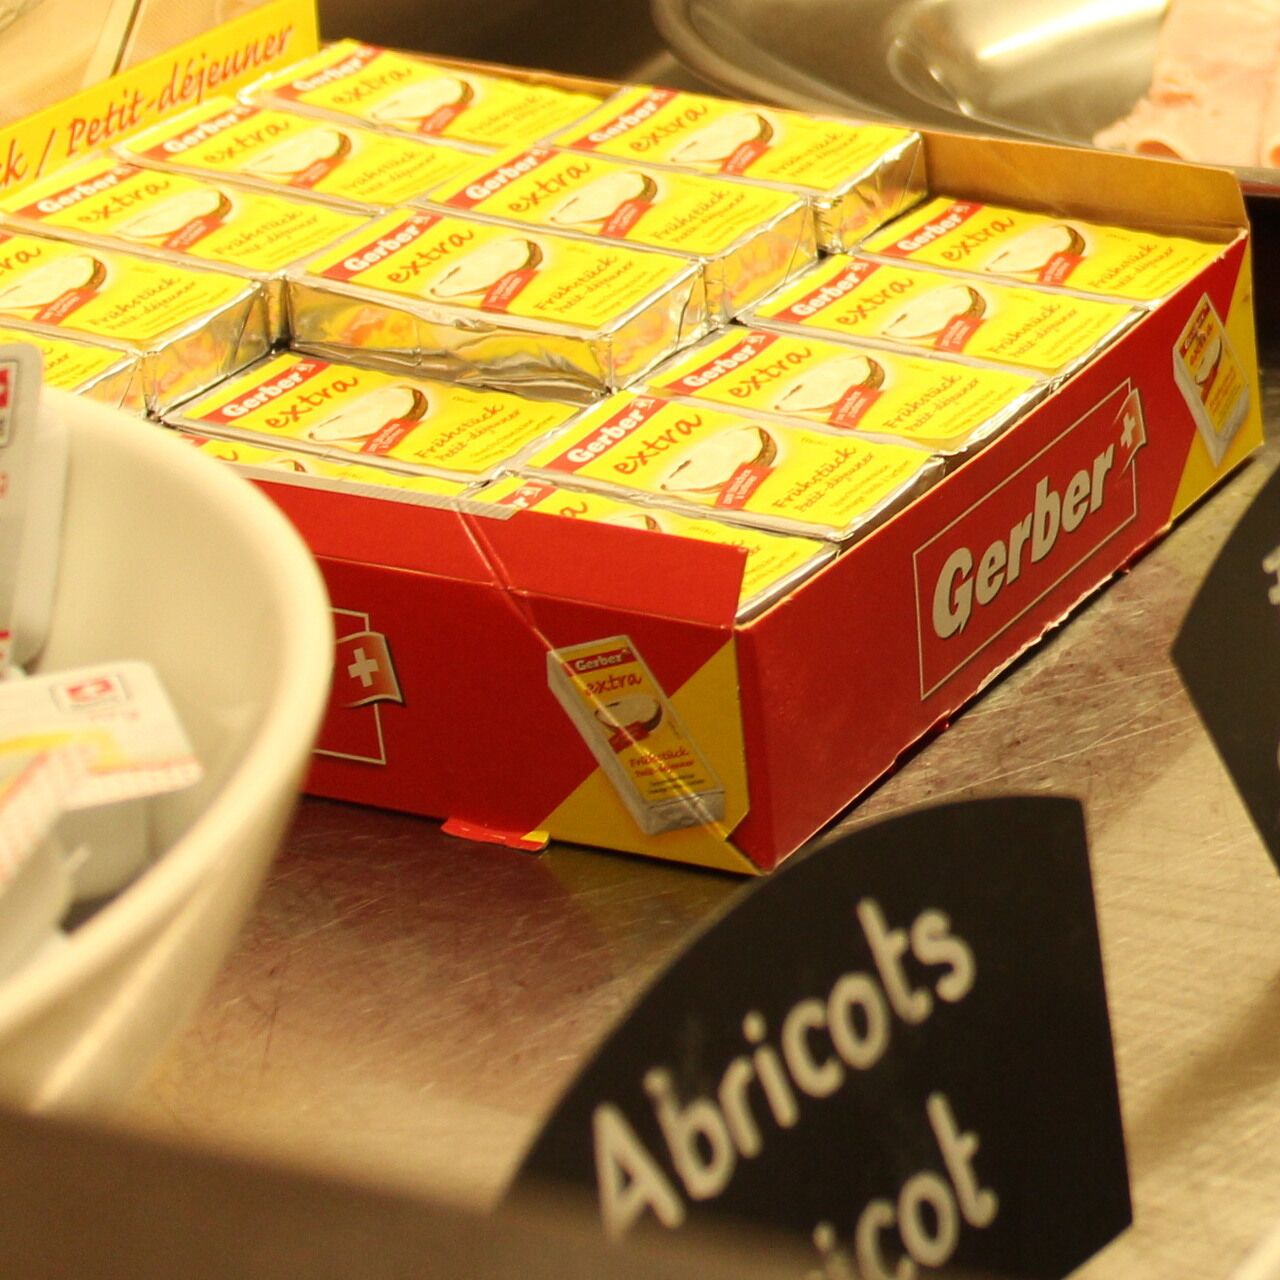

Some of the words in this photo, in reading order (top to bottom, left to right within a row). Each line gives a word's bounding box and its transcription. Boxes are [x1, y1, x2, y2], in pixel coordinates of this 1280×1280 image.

[65, 24, 294, 157] Petit-déjeuner
[588, 98, 658, 143] Gerber
[630, 103, 709, 152] extra
[465, 157, 540, 200] Gerber
[508, 162, 591, 213] extra
[343, 223, 421, 272] Gerber
[897, 211, 965, 252] Gerber
[941, 216, 1015, 263] extra
[387, 229, 474, 284] extra
[791, 271, 860, 317] Gerber
[838, 278, 914, 327] extra
[682, 342, 756, 388] Gerber
[729, 347, 813, 399] extra
[221, 370, 304, 418] Gerber
[265, 375, 359, 429] extra
[567, 408, 646, 464] Gerber
[614, 413, 702, 476] extra
[773, 446, 857, 510] Frühstück
[931, 443, 1115, 639] Gerber
[575, 652, 623, 671] Gerber
[585, 672, 643, 696] extra
[593, 896, 976, 1245] Abricots
